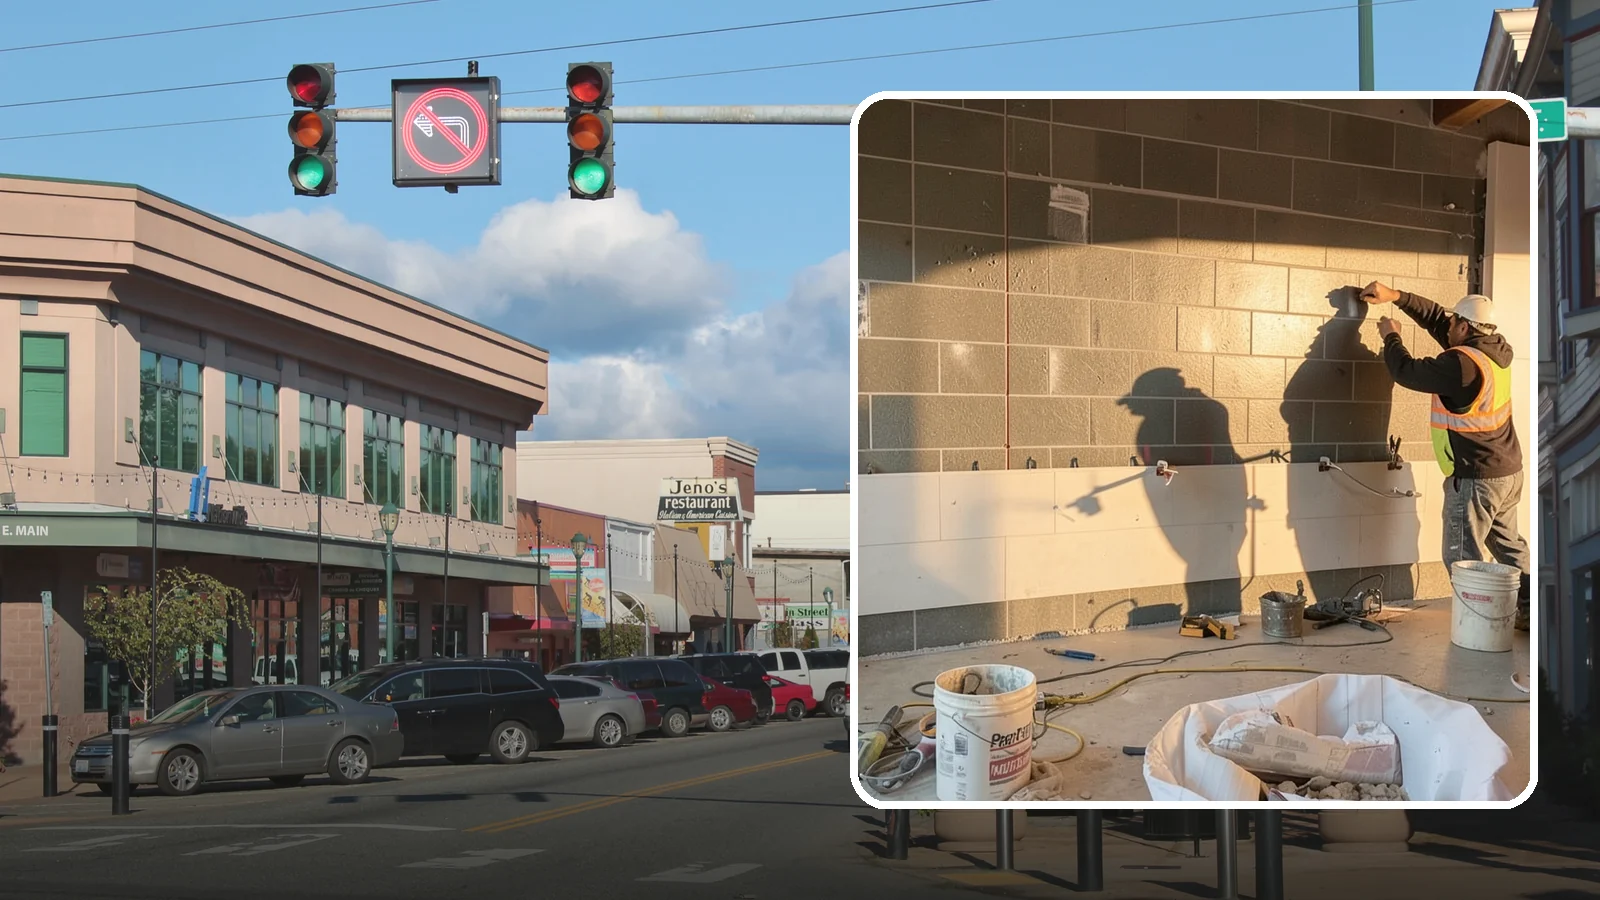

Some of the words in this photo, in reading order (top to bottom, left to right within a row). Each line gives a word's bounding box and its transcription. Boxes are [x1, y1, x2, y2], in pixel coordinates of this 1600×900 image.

[669, 480, 727, 494] Jeno's
[665, 496, 731, 509] restaurant
[686, 509, 714, 519] American
[715, 509, 738, 519] Cuisine
[2, 525, 13, 536] E.
[15, 525, 49, 536] MAIN
[797, 607, 828, 617] Street
